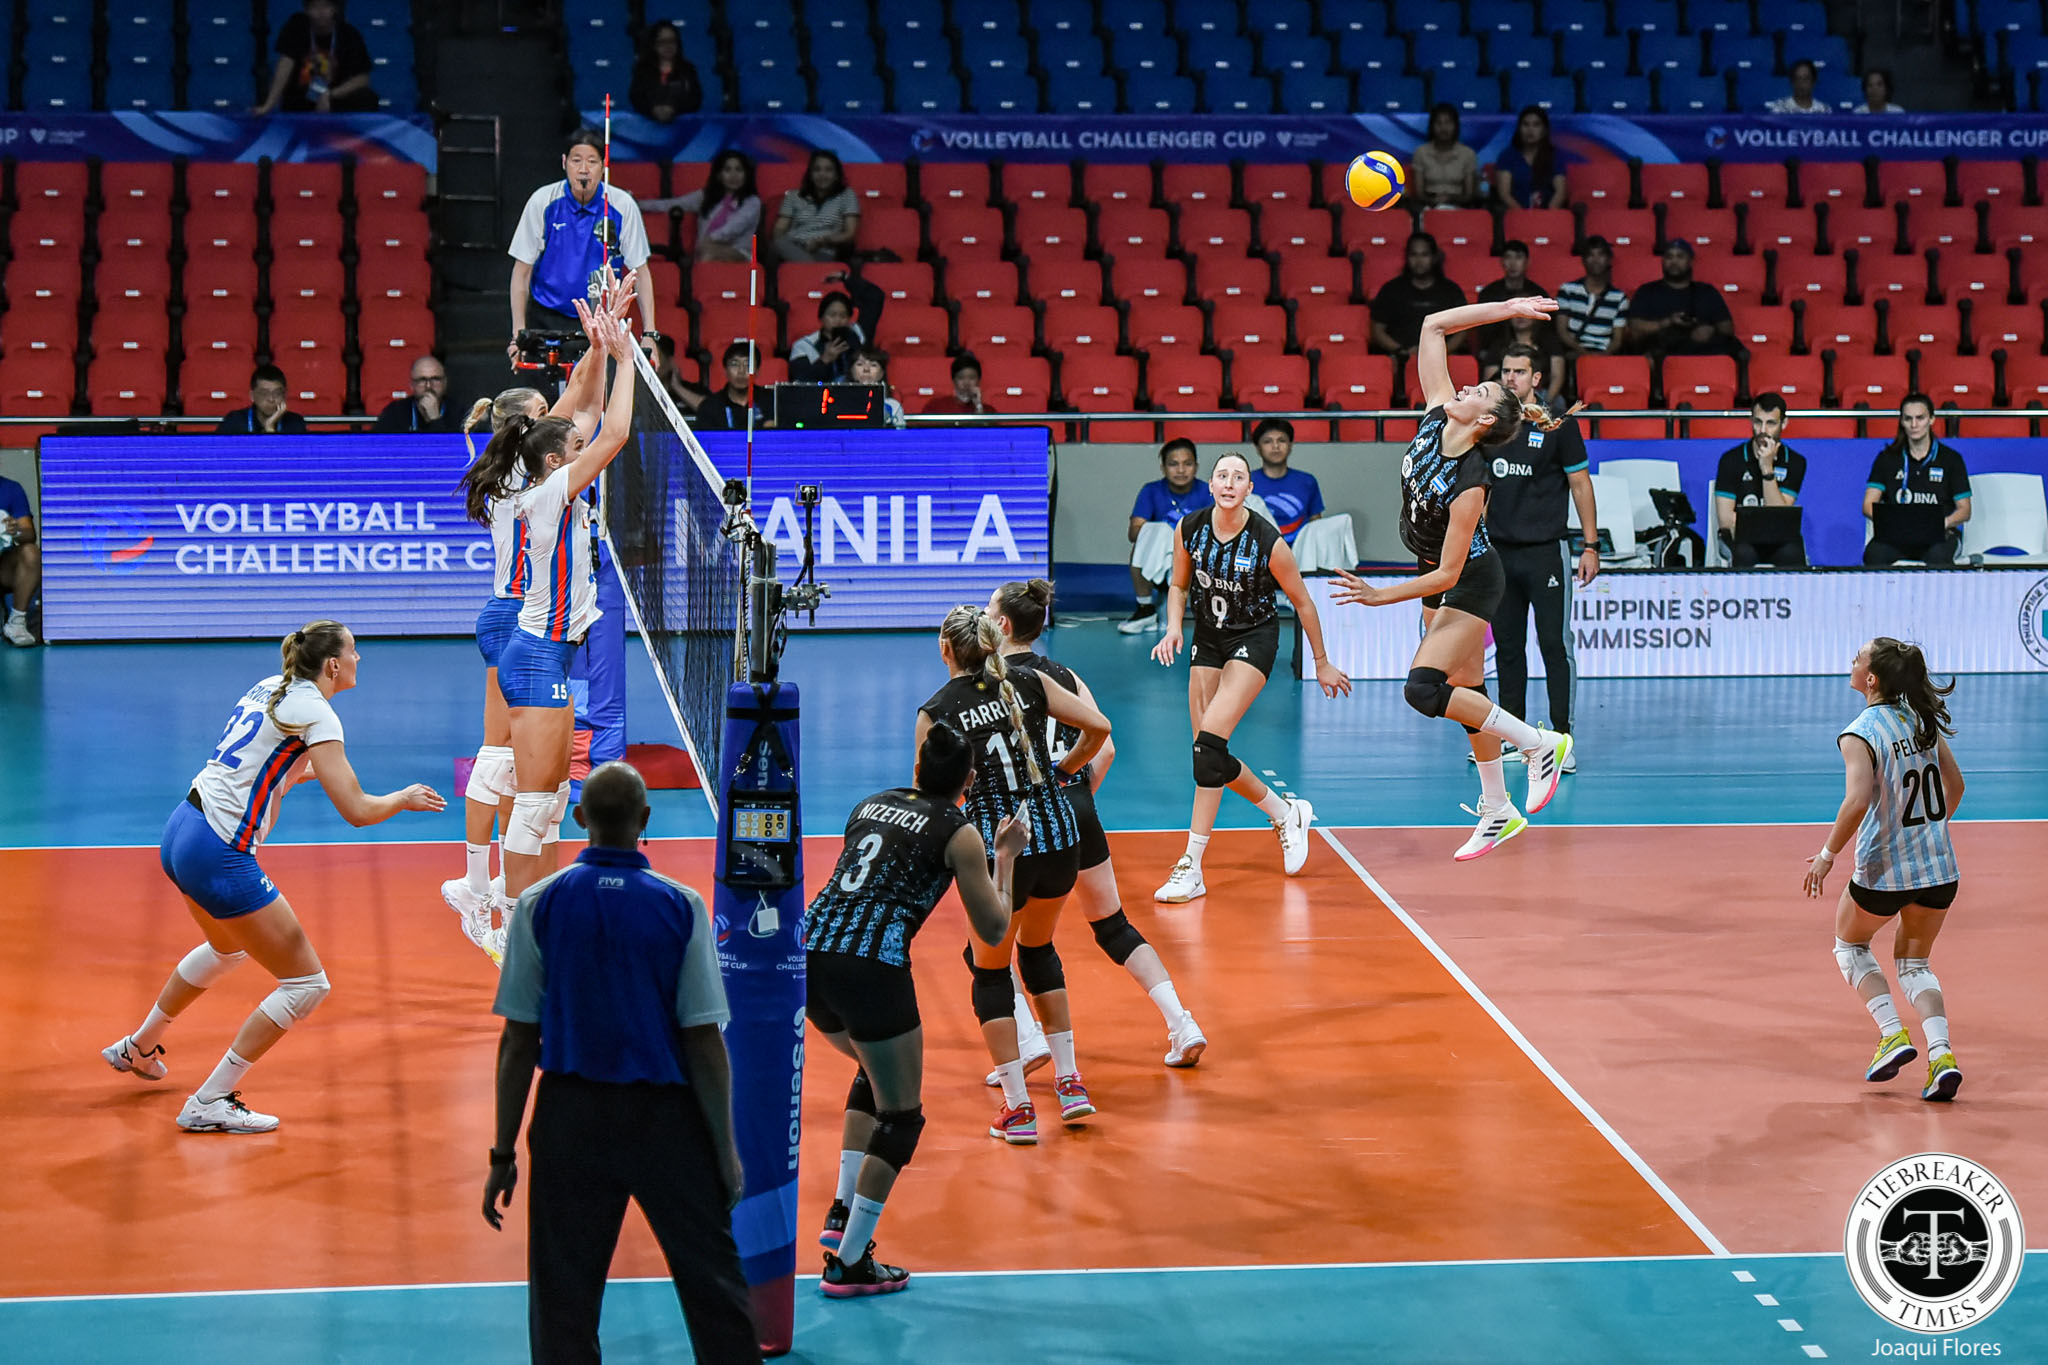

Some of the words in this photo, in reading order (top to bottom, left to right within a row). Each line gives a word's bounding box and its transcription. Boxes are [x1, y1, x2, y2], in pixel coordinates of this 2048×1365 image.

[941, 131, 1072, 149] VOLLEYBALL
[1079, 130, 1216, 149] CHALLENGER
[1223, 130, 1266, 148] CUP
[1733, 129, 1861, 147] VOLLEYBALL
[1868, 129, 2002, 147] CHALLENGER
[2009, 129, 2048, 147] CUP
[1508, 463, 1533, 476] BNA
[1913, 492, 1938, 505] BNA
[175, 501, 435, 534] VOLLEYBALL
[674, 494, 1021, 565] ANILA
[175, 541, 449, 574] CHALLENGER
[1214, 578, 1244, 593] BNA
[1211, 595, 1227, 629] 9
[1573, 598, 1681, 621] ILIPPINE
[1690, 597, 1792, 620] SPORTS
[1577, 627, 1712, 650] MMISSION
[552, 683, 568, 700] 15
[959, 691, 1030, 732] FARRIL
[1902, 763, 1947, 828] 20
[857, 803, 930, 834] NIZETICH
[840, 833, 883, 892] 3
[730, 961, 748, 970] CUP
